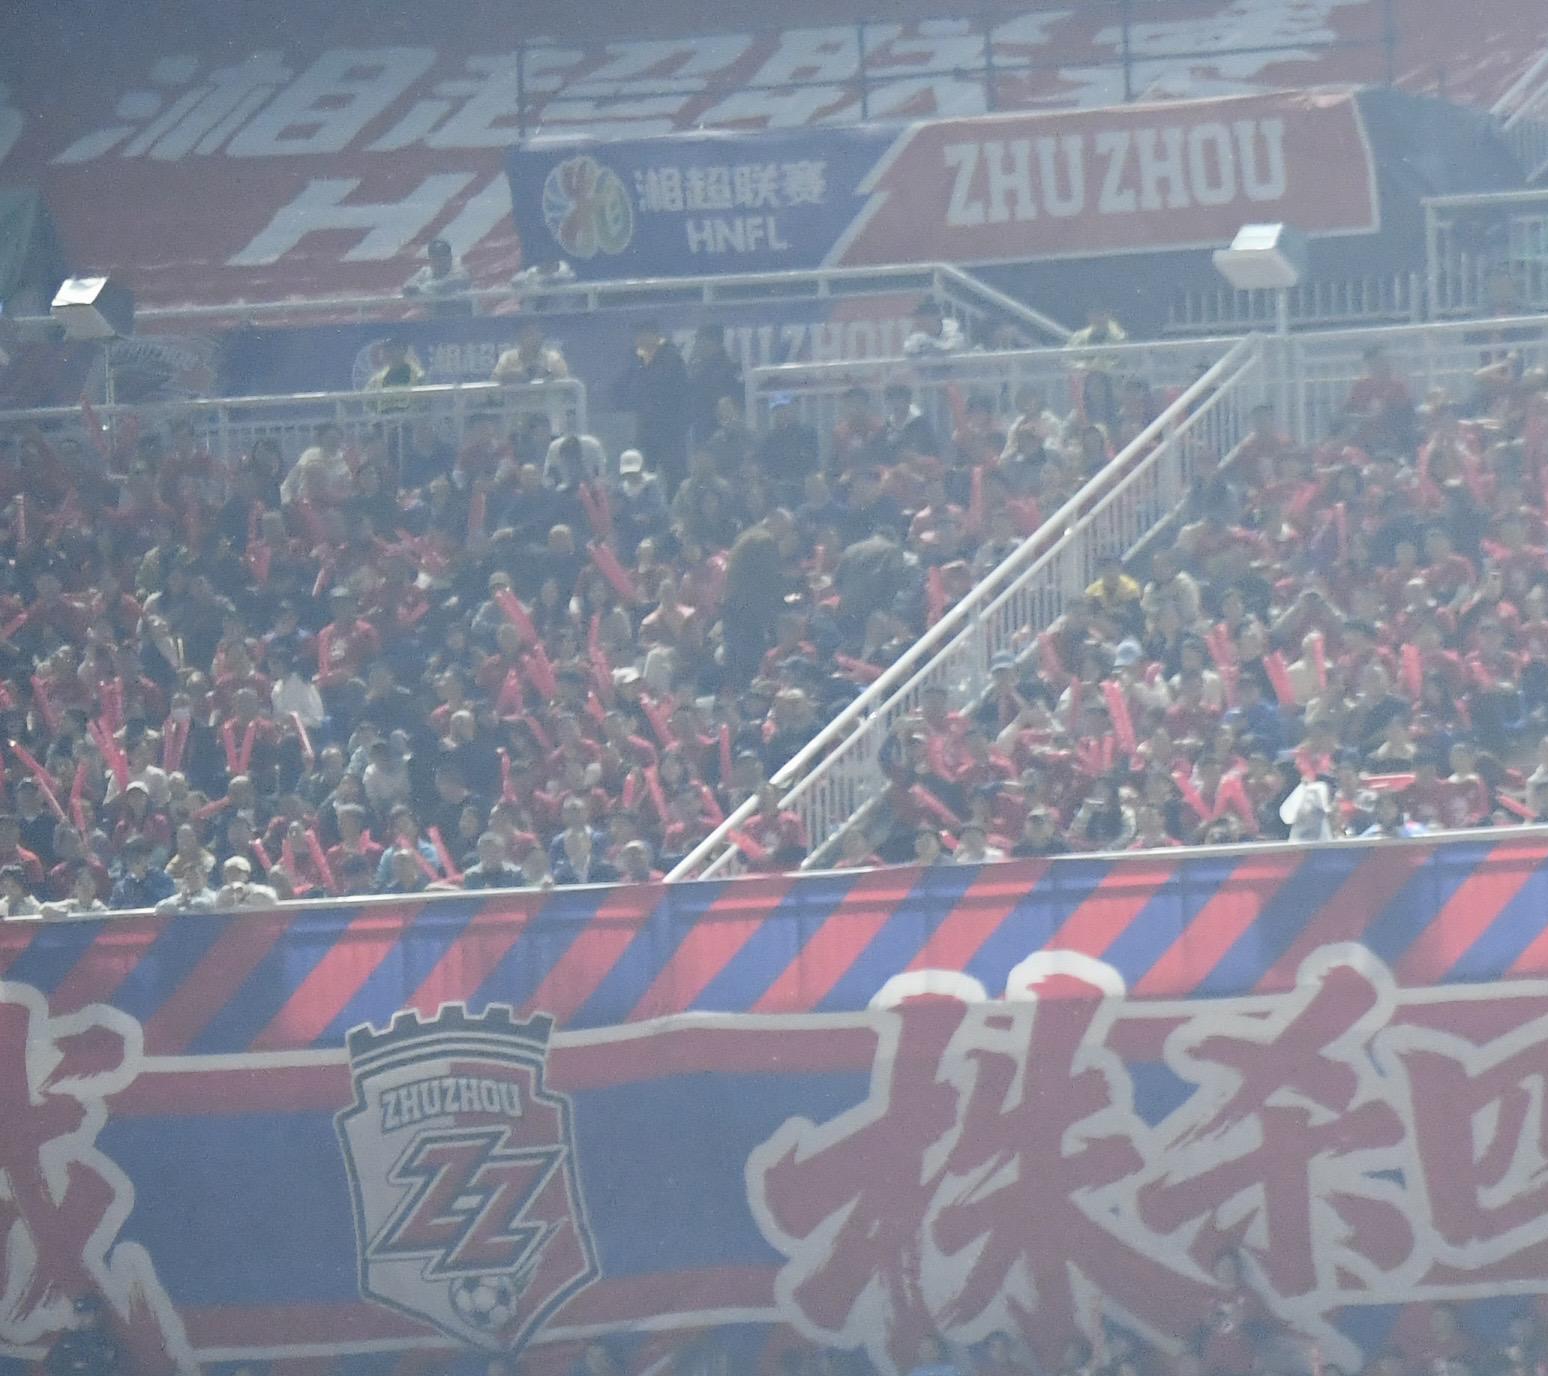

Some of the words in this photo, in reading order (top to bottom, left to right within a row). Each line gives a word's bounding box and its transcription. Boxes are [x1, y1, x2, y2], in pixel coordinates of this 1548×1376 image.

[634, 158, 826, 213] 湘超联赛
[687, 214, 790, 254] HNFL
[380, 1076, 523, 1131] ZHUZHOU
